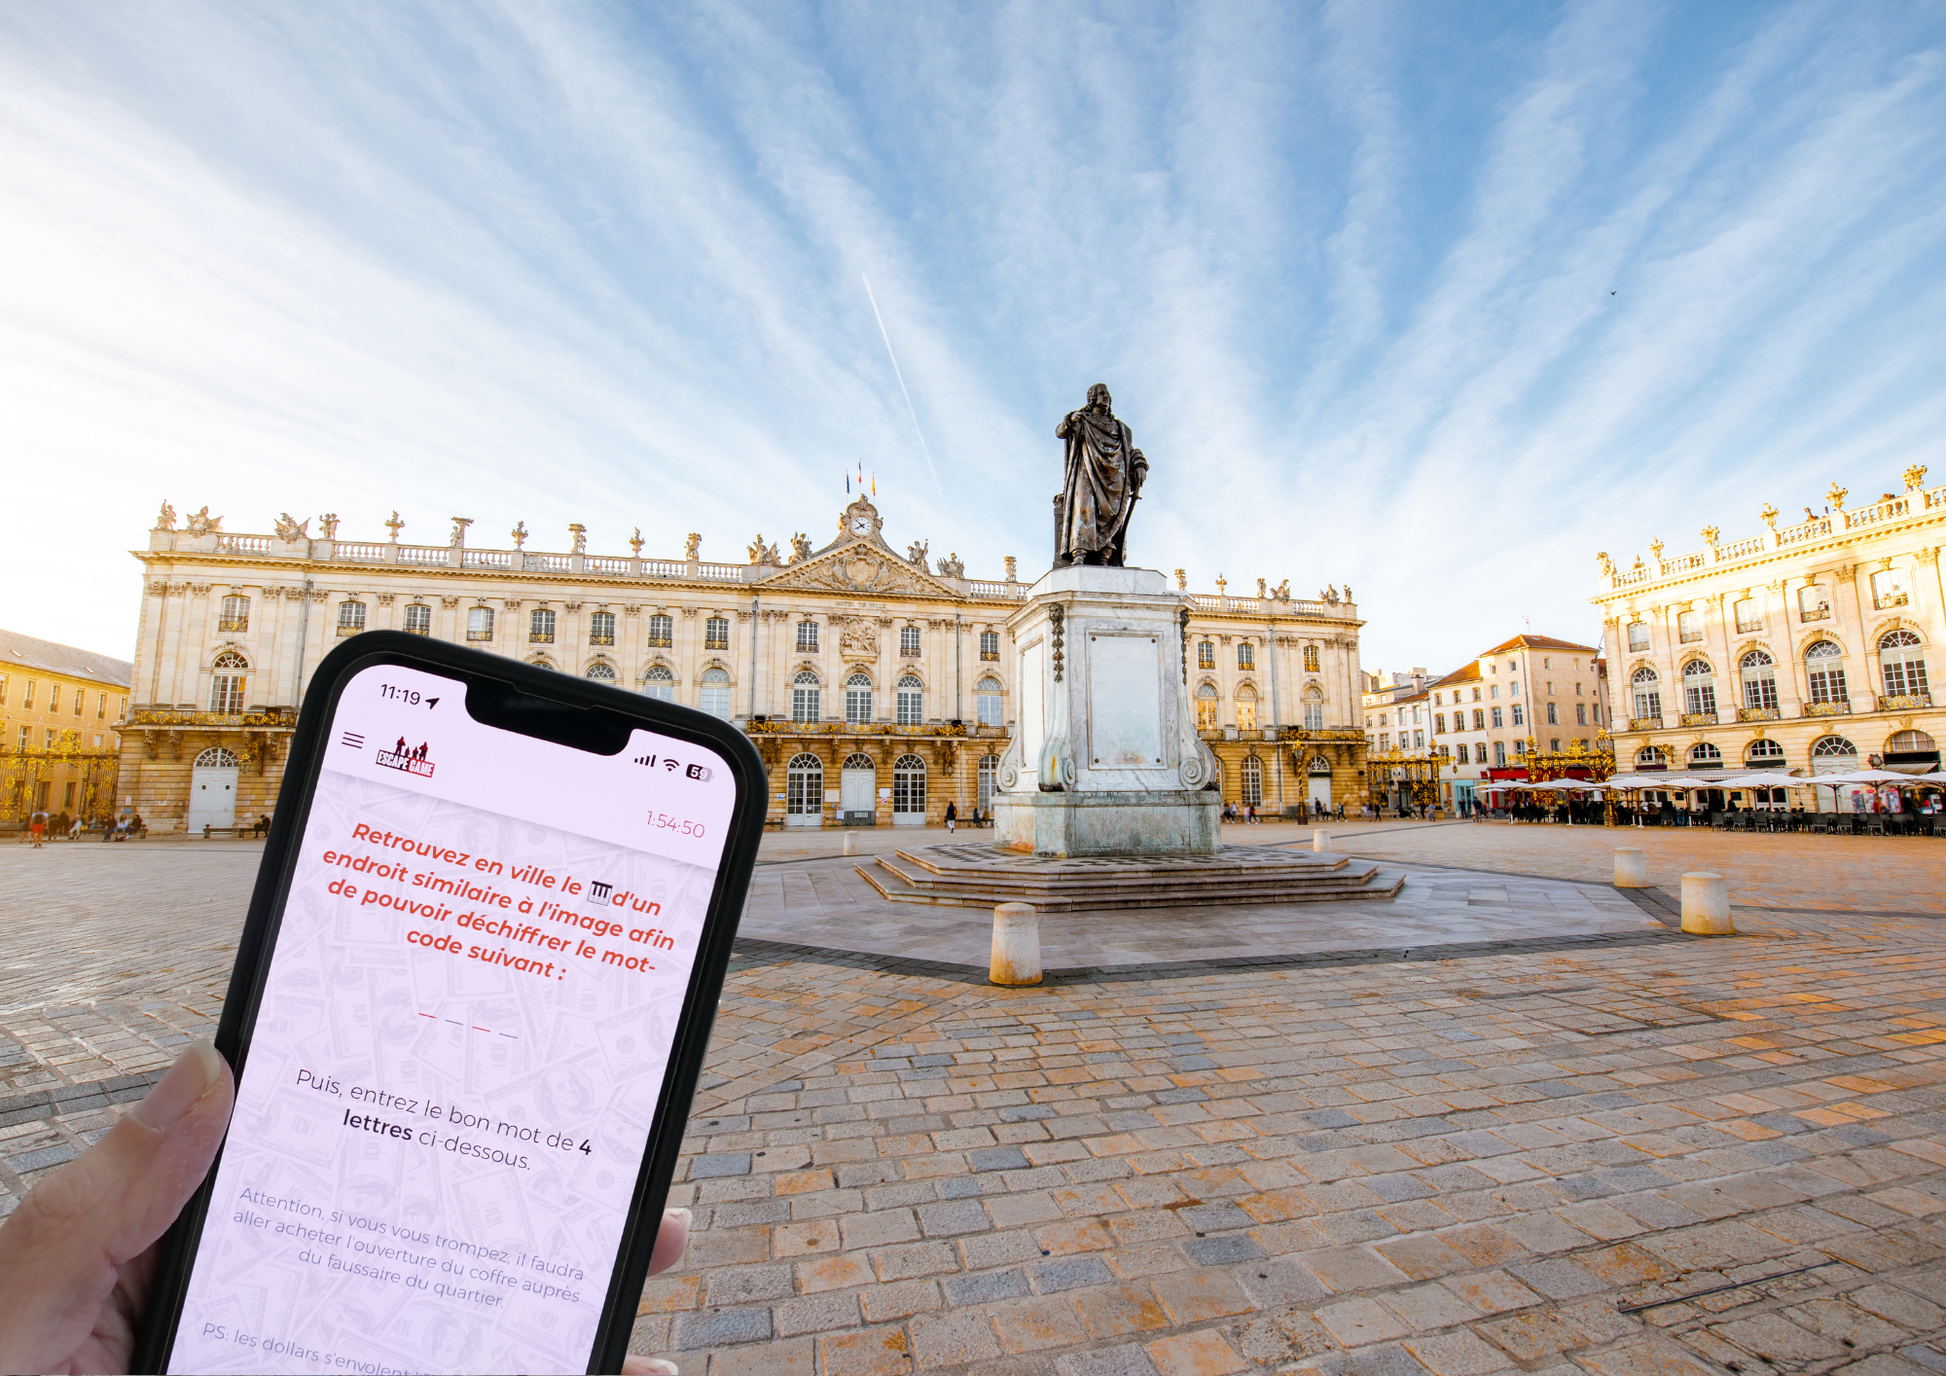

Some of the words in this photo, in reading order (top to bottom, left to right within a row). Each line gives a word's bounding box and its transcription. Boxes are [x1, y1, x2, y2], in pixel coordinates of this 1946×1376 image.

[381, 684, 420, 705] 11:19
[379, 751, 410, 771] ESCAPE
[409, 759, 434, 777] GAME
[690, 766, 708, 780] 59
[647, 810, 705, 838] 1:54:50
[352, 823, 470, 866] Retrouvez
[475, 859, 503, 875] en
[512, 865, 555, 888] ville
[561, 876, 582, 896] le
[612, 891, 661, 916] d'un
[323, 851, 408, 882] endroit
[412, 872, 512, 908] similaire
[518, 896, 533, 914] à
[538, 901, 623, 936] l'image
[629, 929, 674, 950] afin
[328, 879, 357, 898] de
[361, 890, 452, 921] pouvoir
[457, 912, 572, 952] déchiffrer
[575, 940, 596, 959] le
[601, 951, 655, 972] mot-
[407, 931, 462, 954] code
[467, 946, 554, 977] suivant
[297, 1069, 342, 1097] Puis,
[351, 1087, 418, 1113] entrez
[424, 1100, 442, 1118] le
[449, 1106, 489, 1131] bon
[497, 1122, 541, 1143] mot
[547, 1132, 573, 1150] de
[579, 1139, 592, 1155] 4
[343, 1109, 413, 1140] lettres
[419, 1131, 530, 1170] ci-dessous.
[233, 1211, 270, 1228] aller
[275, 1222, 342, 1245] acheter
[347, 1235, 436, 1268] l'ouverture
[442, 1260, 464, 1275] du
[470, 1269, 517, 1287] coffre
[522, 1281, 579, 1302] auprès
[239, 1188, 324, 1220] Attention,
[330, 1210, 343, 1223] si
[349, 1215, 386, 1233] vous
[392, 1226, 430, 1244] vous
[436, 1235, 510, 1265] trompez,
[517, 1252, 526, 1266] il
[531, 1256, 583, 1280] faudra
[299, 1249, 321, 1265] du
[328, 1254, 400, 1283] faussaire
[406, 1275, 428, 1290] du
[434, 1283, 503, 1308] quartier.
[203, 1323, 229, 1340] PS:
[234, 1330, 257, 1347] les
[263, 1338, 318, 1361] dollars
